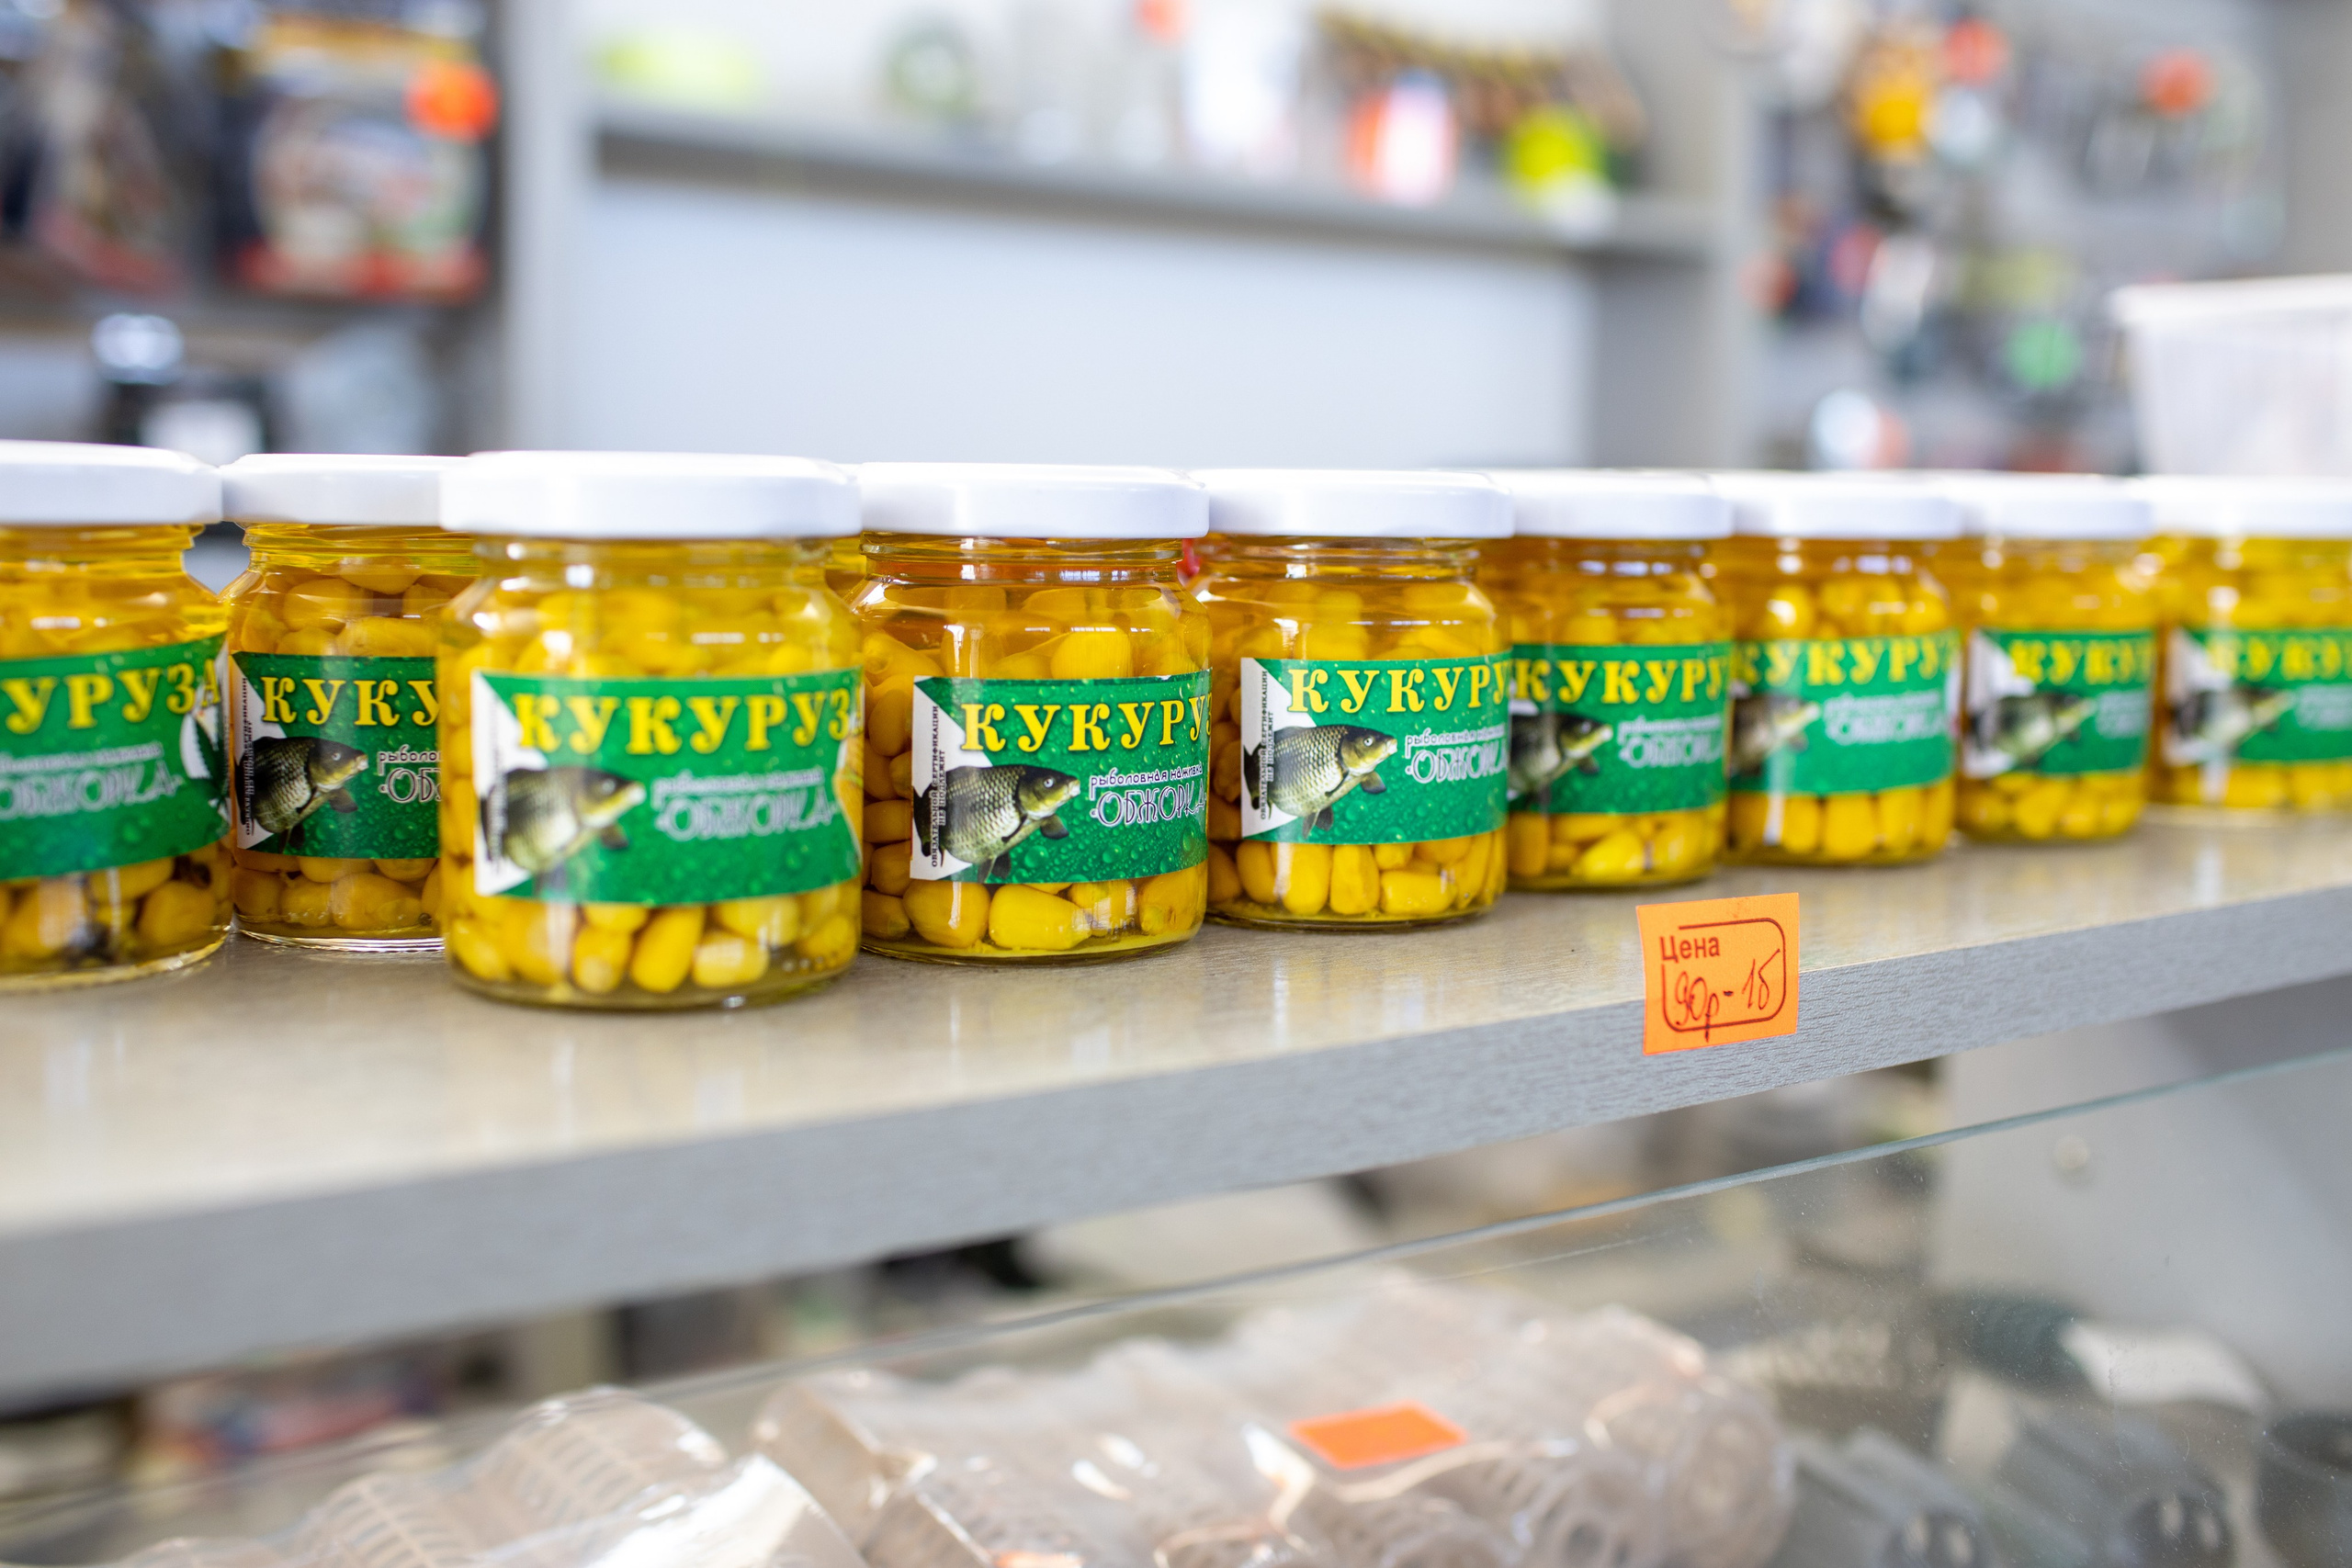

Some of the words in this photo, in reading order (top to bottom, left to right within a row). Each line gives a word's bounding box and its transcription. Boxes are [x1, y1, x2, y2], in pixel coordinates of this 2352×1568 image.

[378, 744, 441, 776] рыболо
[1090, 767, 1169, 801] рыболовная
[1660, 935, 1720, 963] Цена
